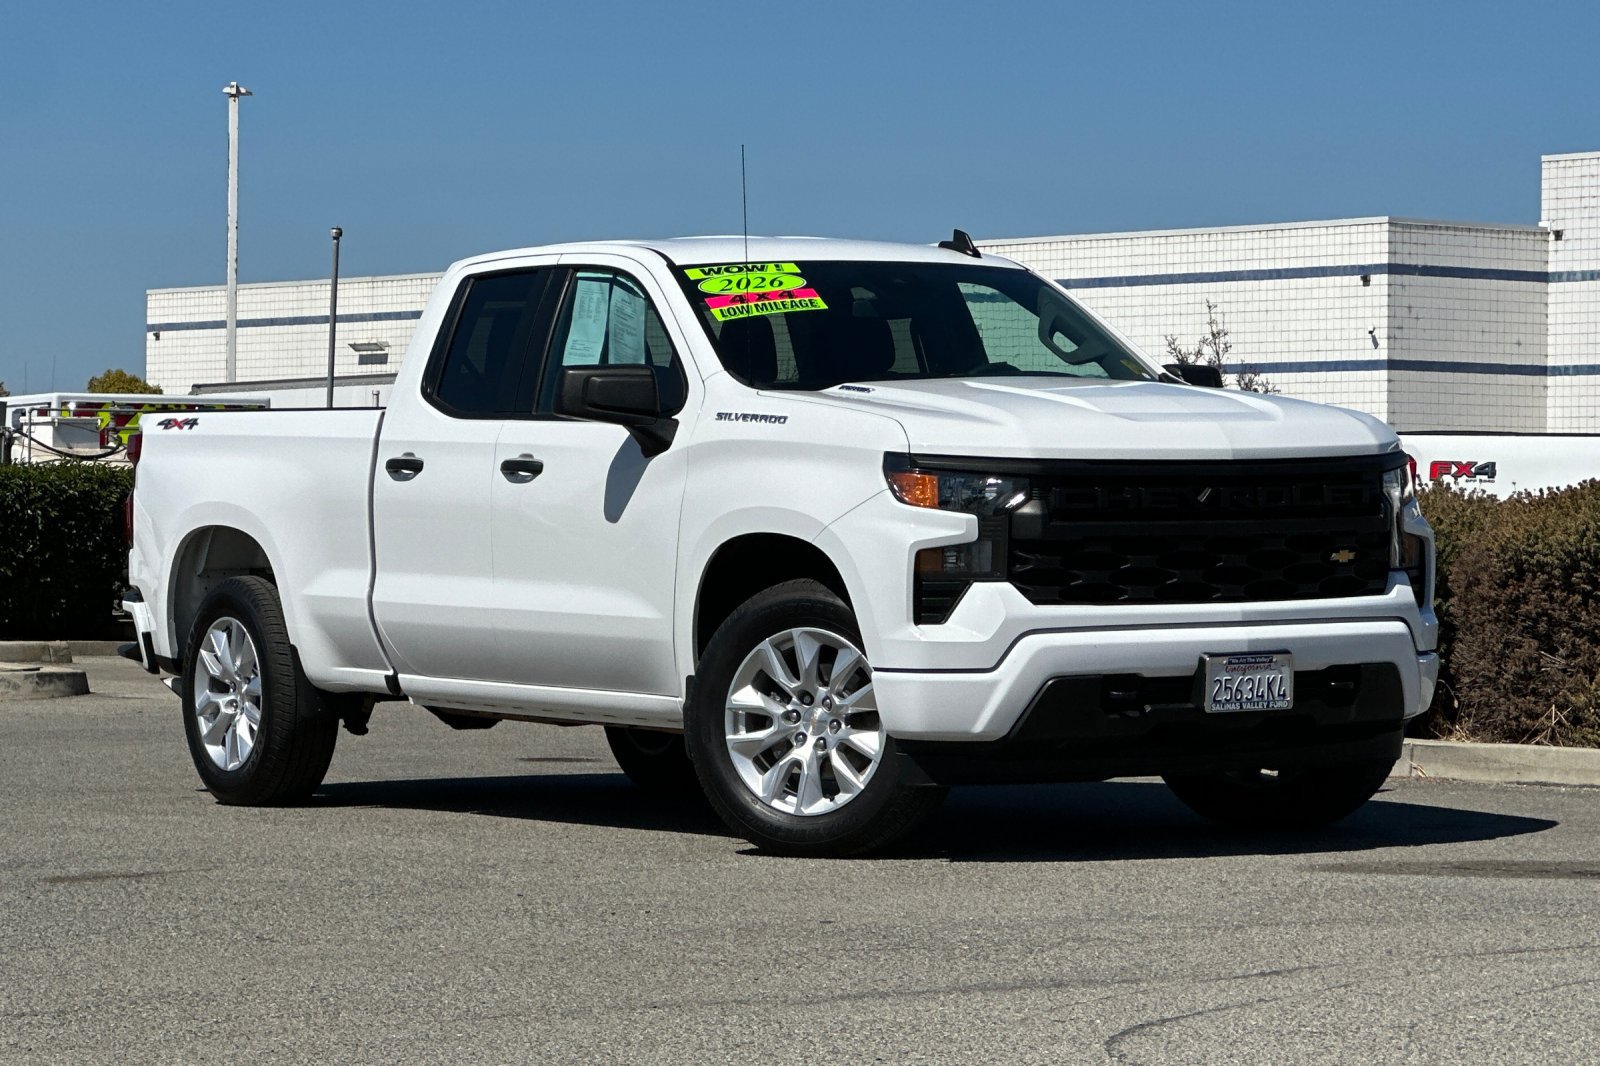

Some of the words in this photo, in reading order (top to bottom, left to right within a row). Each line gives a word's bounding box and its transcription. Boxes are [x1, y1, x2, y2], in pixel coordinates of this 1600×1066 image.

[701, 265, 767, 276] WOW
[719, 276, 784, 291] 2026
[720, 305, 750, 317] LOW
[756, 299, 818, 313] MILEAGE
[715, 412, 788, 424] SILVERADO
[1429, 460, 1496, 481] FX4
[1055, 484, 1376, 511] CHEVROLET
[1213, 674, 1286, 702] 25634K4
[1211, 702, 1240, 711] SALINAS
